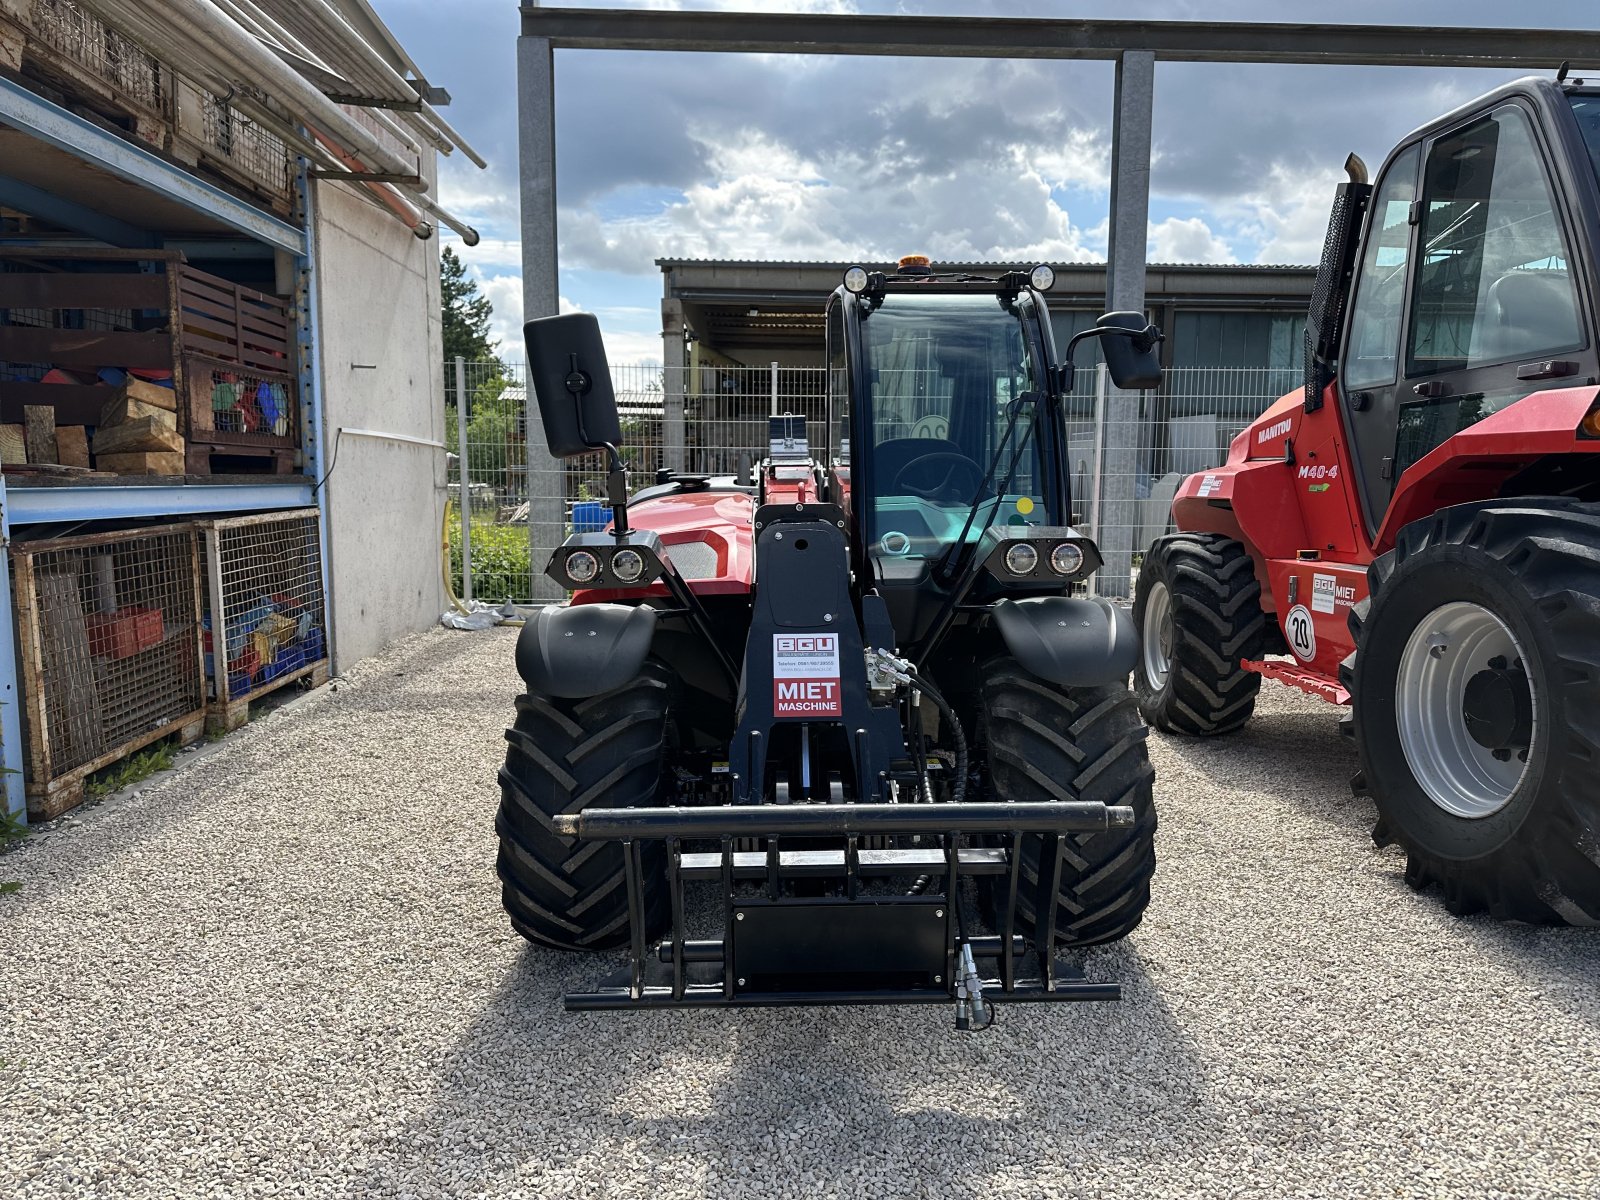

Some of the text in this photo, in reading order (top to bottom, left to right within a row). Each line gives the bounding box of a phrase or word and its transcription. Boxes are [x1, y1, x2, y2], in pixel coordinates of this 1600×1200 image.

[1258, 418, 1292, 444] MANITOU
[1314, 578, 1335, 592] BGU
[1336, 586, 1355, 599] MIET
[1293, 617, 1309, 649] 20
[777, 638, 834, 651] BGU
[778, 683, 836, 699] MIET
[778, 701, 837, 711] MASCHINE
